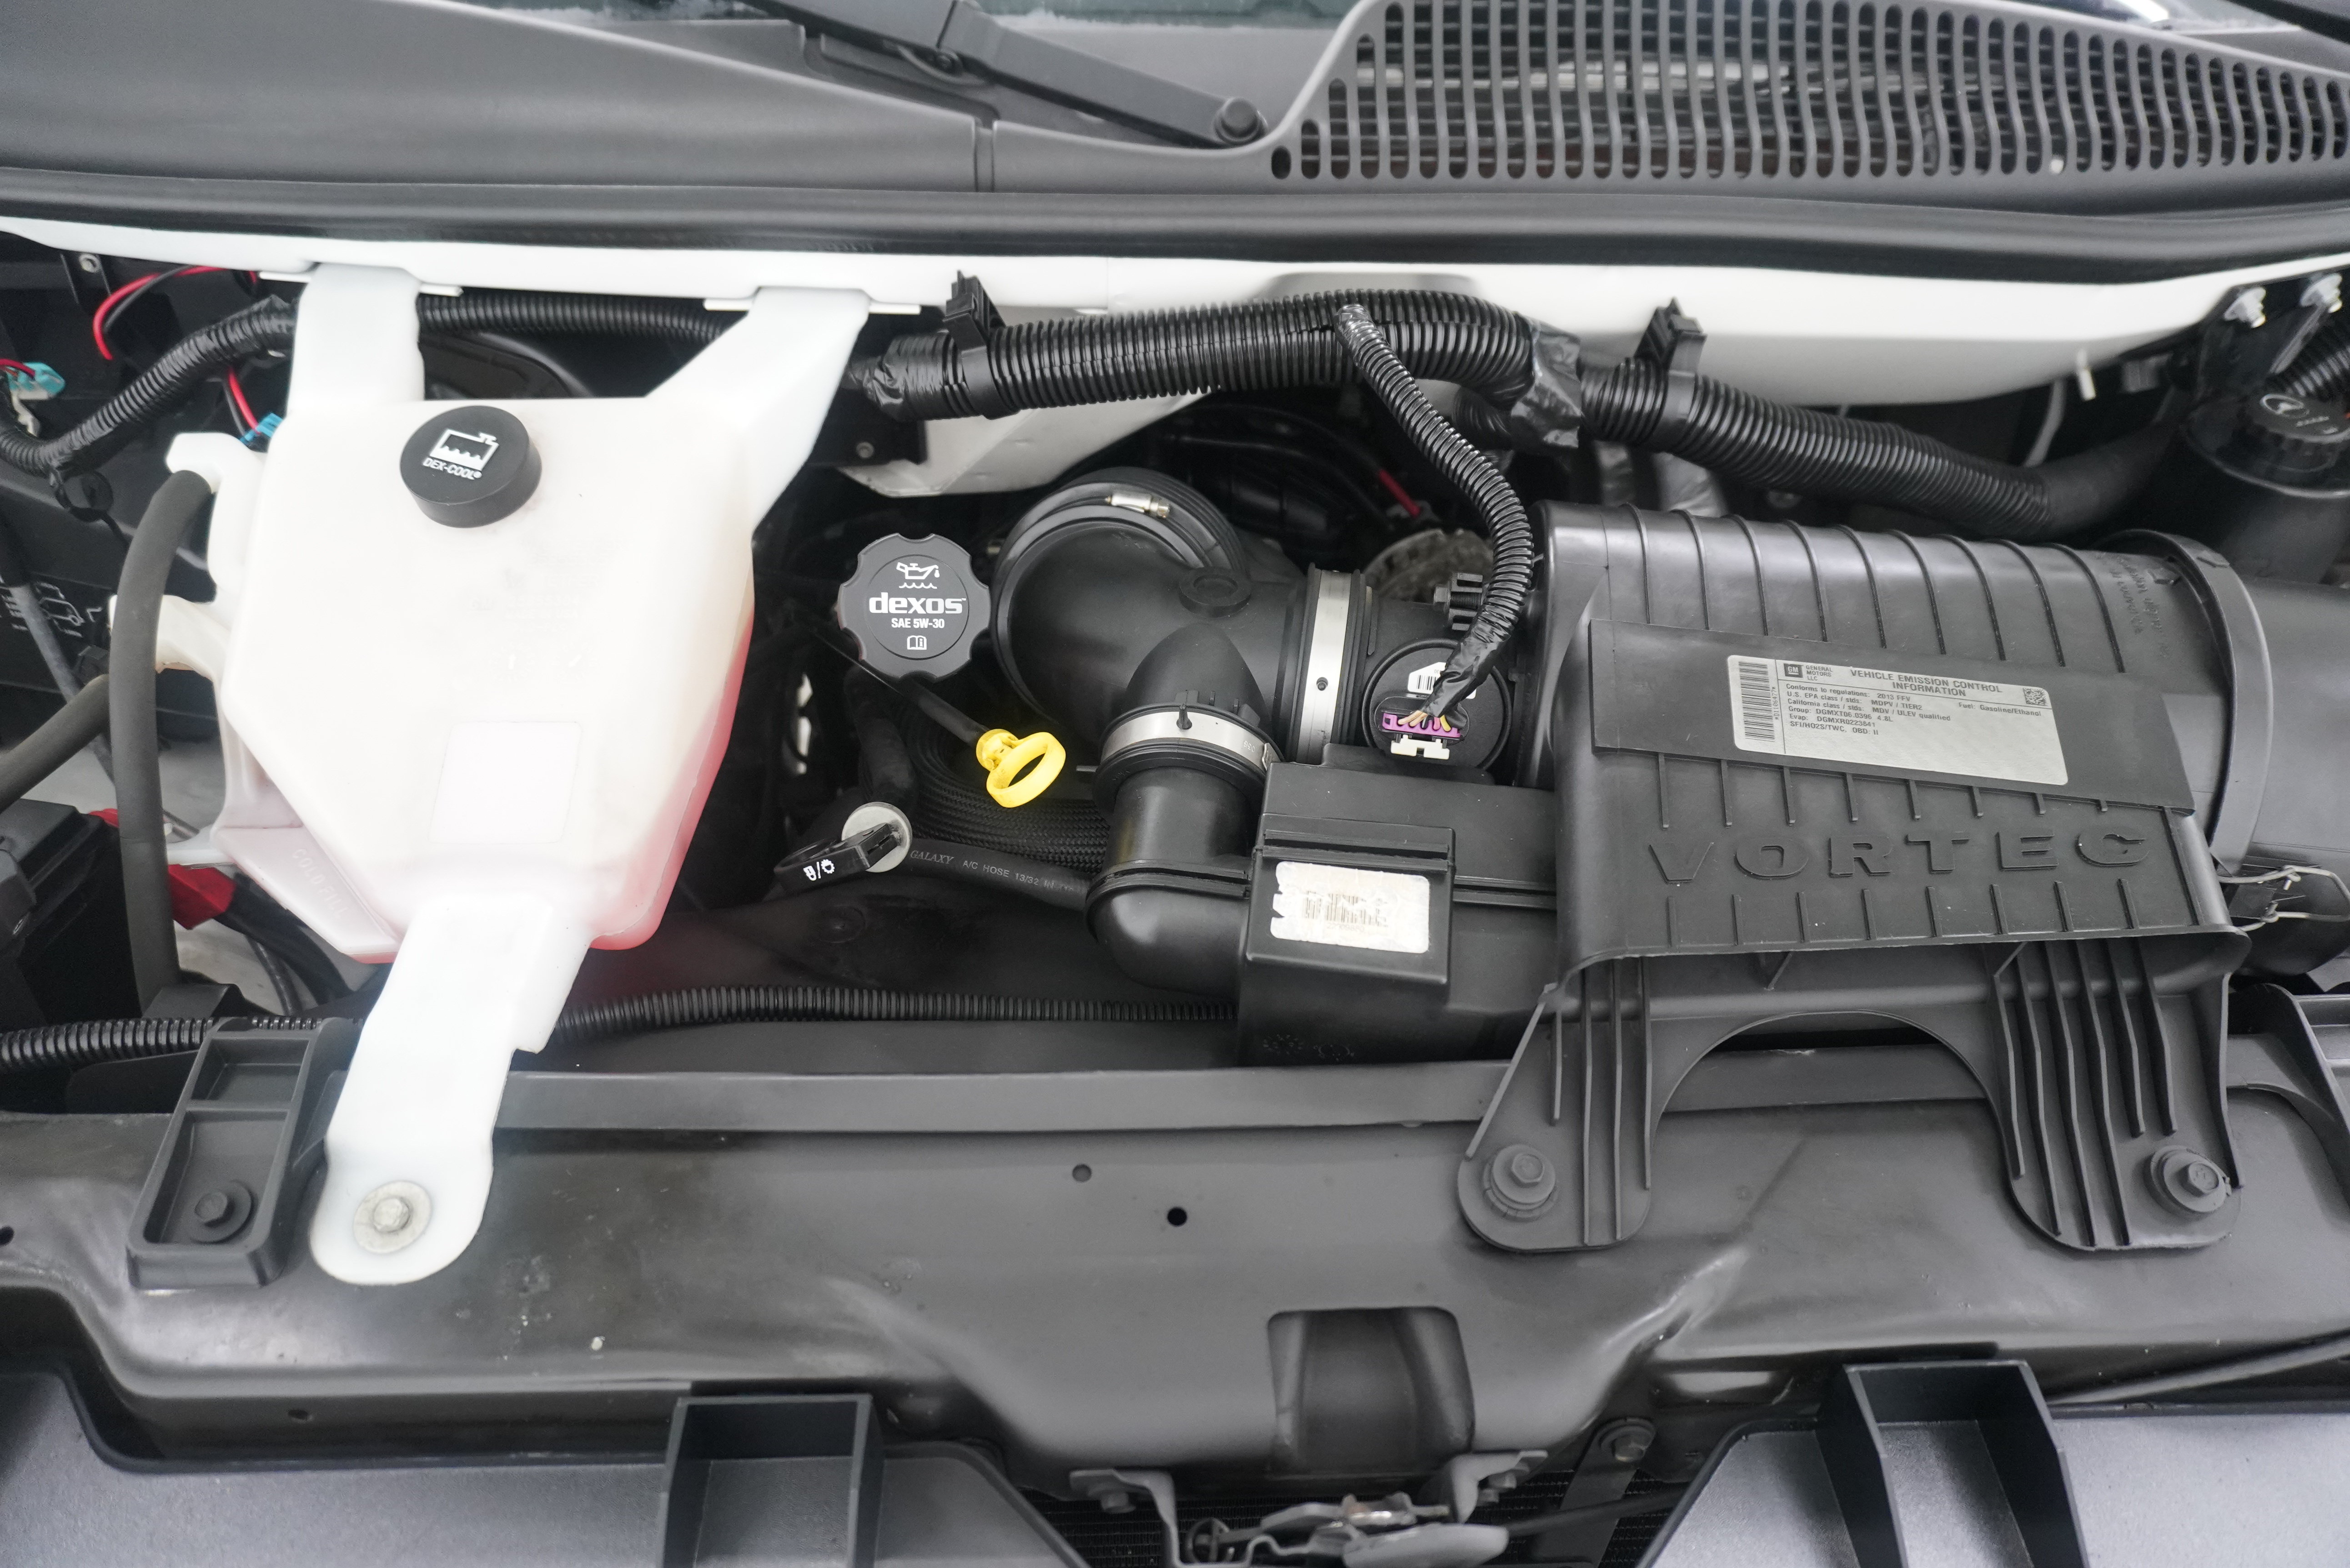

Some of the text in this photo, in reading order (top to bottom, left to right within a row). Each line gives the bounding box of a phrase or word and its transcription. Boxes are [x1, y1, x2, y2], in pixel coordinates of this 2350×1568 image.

[869, 592, 963, 614] dexos
[891, 618, 945, 628] SAE 5W-30
[1786, 683, 1818, 692] Conforms
[1830, 689, 1870, 697] regulations:
[1850, 669, 2003, 693] VEHICLE EMISSION CONTROL
[1893, 682, 1966, 697] INFORMATION
[1980, 704, 2041, 716] Gasoline/Ethanol
[1649, 827, 2150, 882] VORTEC
[910, 850, 954, 864] GALAXY
[963, 859, 978, 869] A/C
[982, 864, 1009, 878] HOSE
[1015, 873, 1039, 885] 13/32
